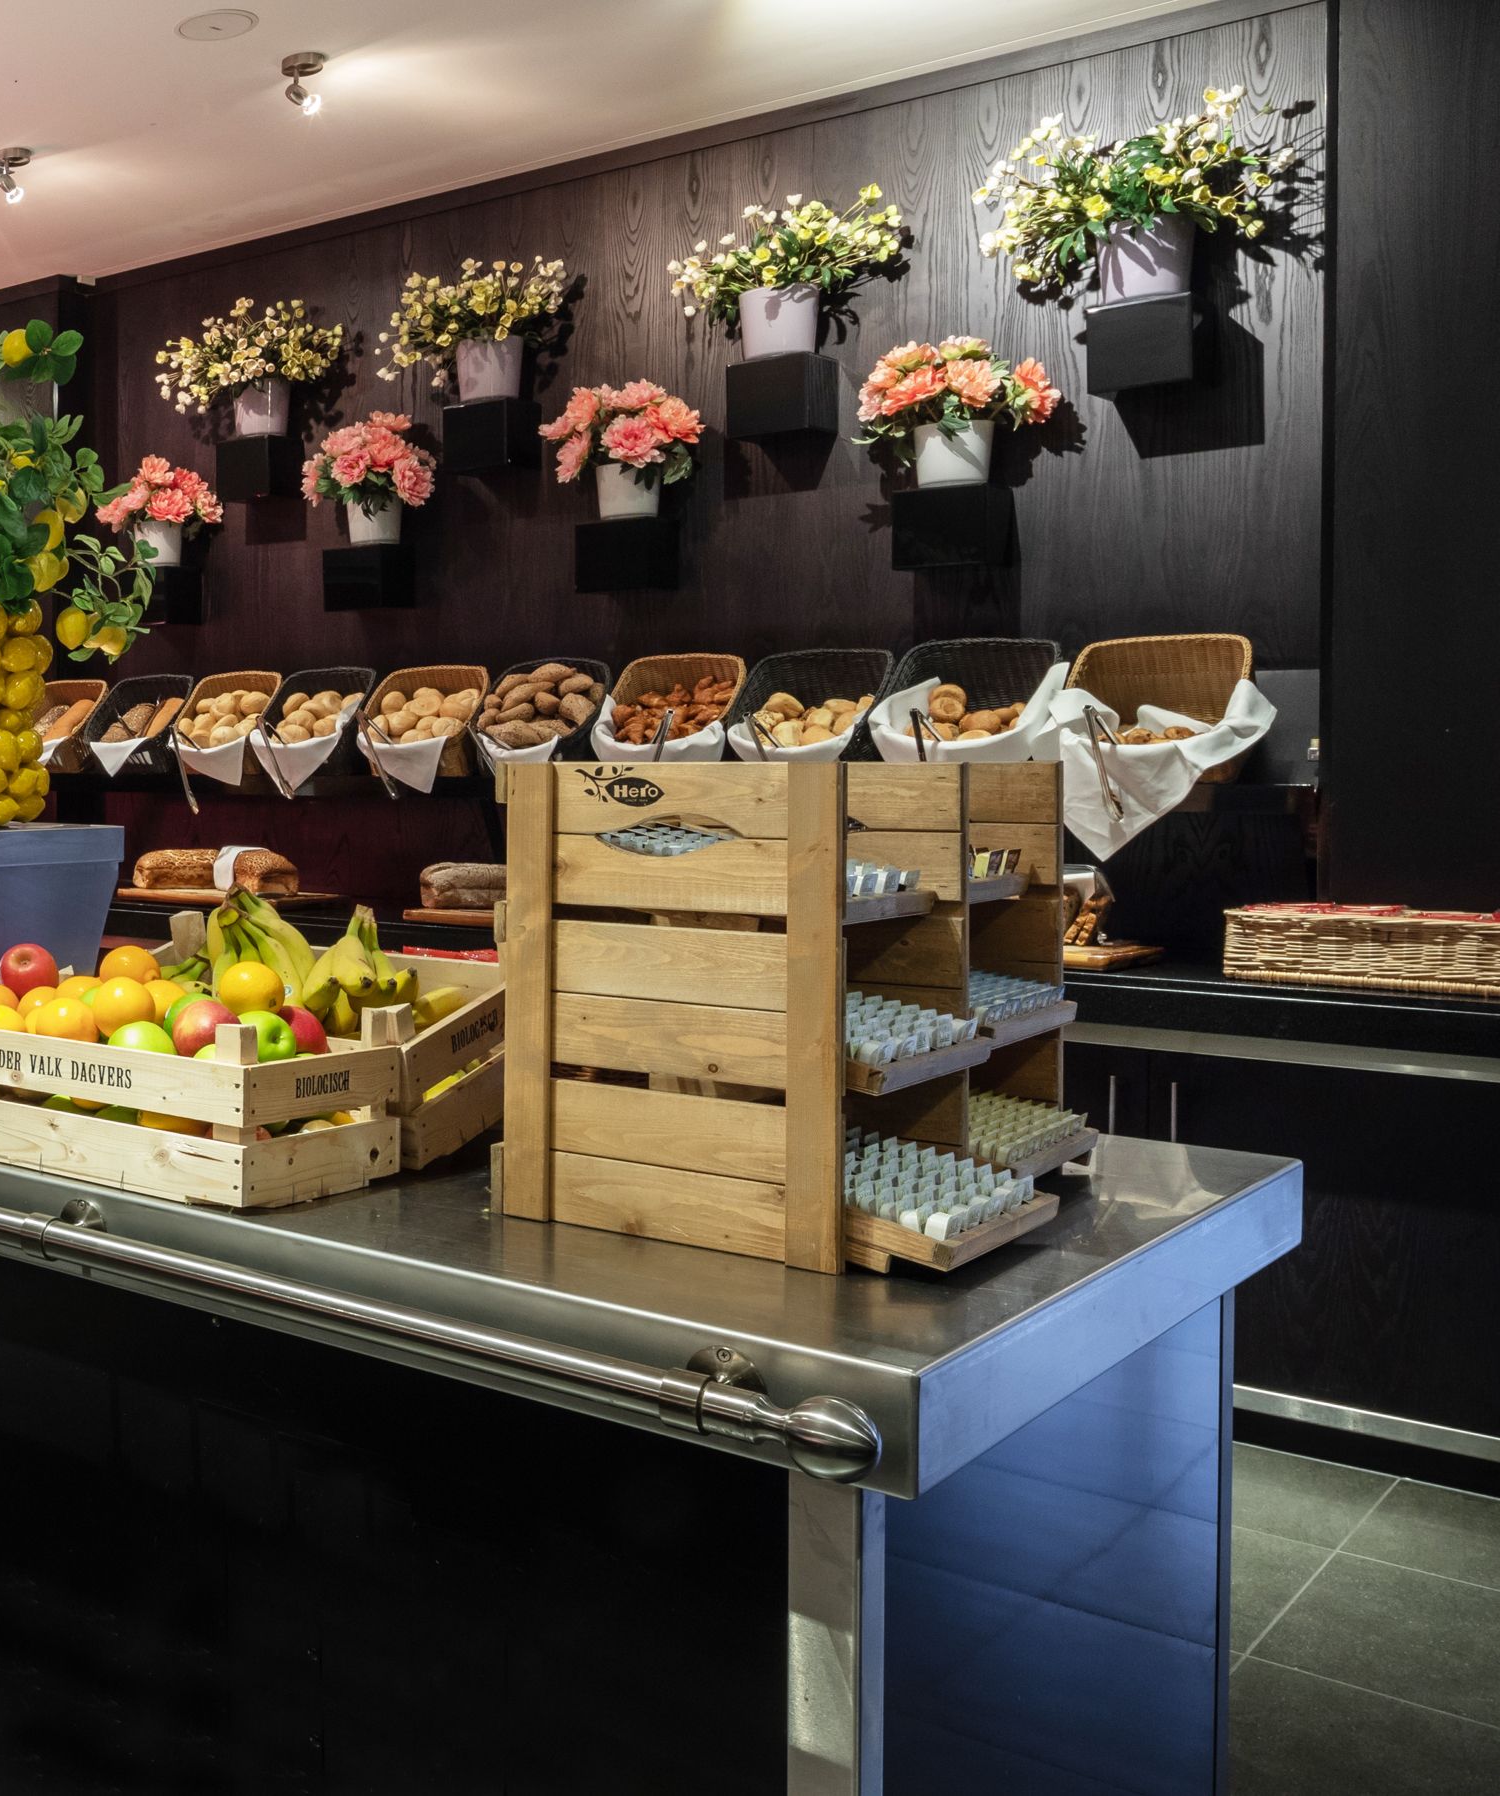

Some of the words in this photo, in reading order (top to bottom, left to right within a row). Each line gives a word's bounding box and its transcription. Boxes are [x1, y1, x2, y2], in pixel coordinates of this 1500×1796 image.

[613, 784, 659, 798] Hero
[30, 1054, 62, 1078] VALK
[70, 1060, 132, 1089] DAGVERS
[295, 1070, 350, 1099] BIOLOGISCH
